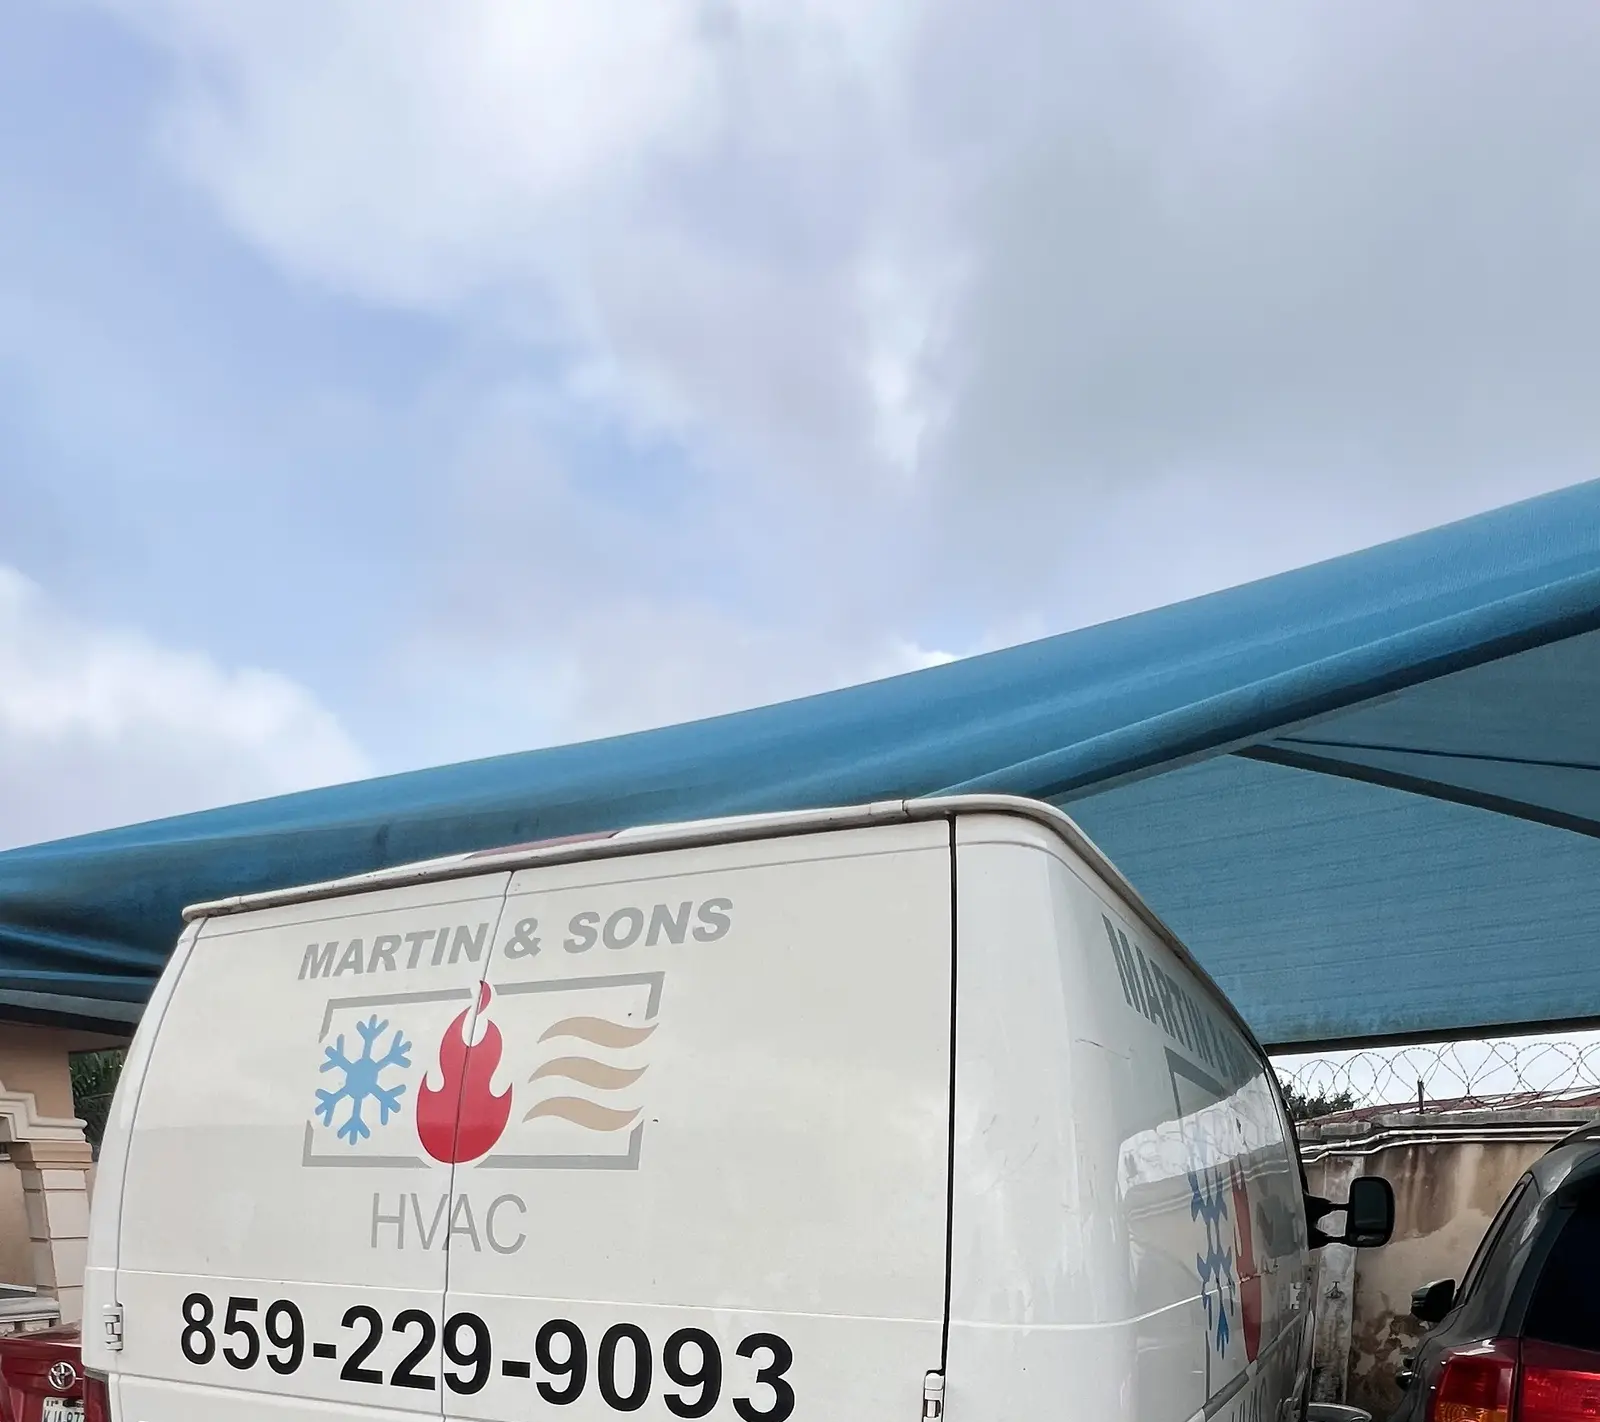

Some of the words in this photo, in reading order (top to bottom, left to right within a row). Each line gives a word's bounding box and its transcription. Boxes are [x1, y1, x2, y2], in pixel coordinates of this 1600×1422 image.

[298, 922, 489, 980] MARTIN
[503, 917, 542, 960] &
[563, 897, 735, 955] SONS
[370, 1191, 528, 1255] HVAC
